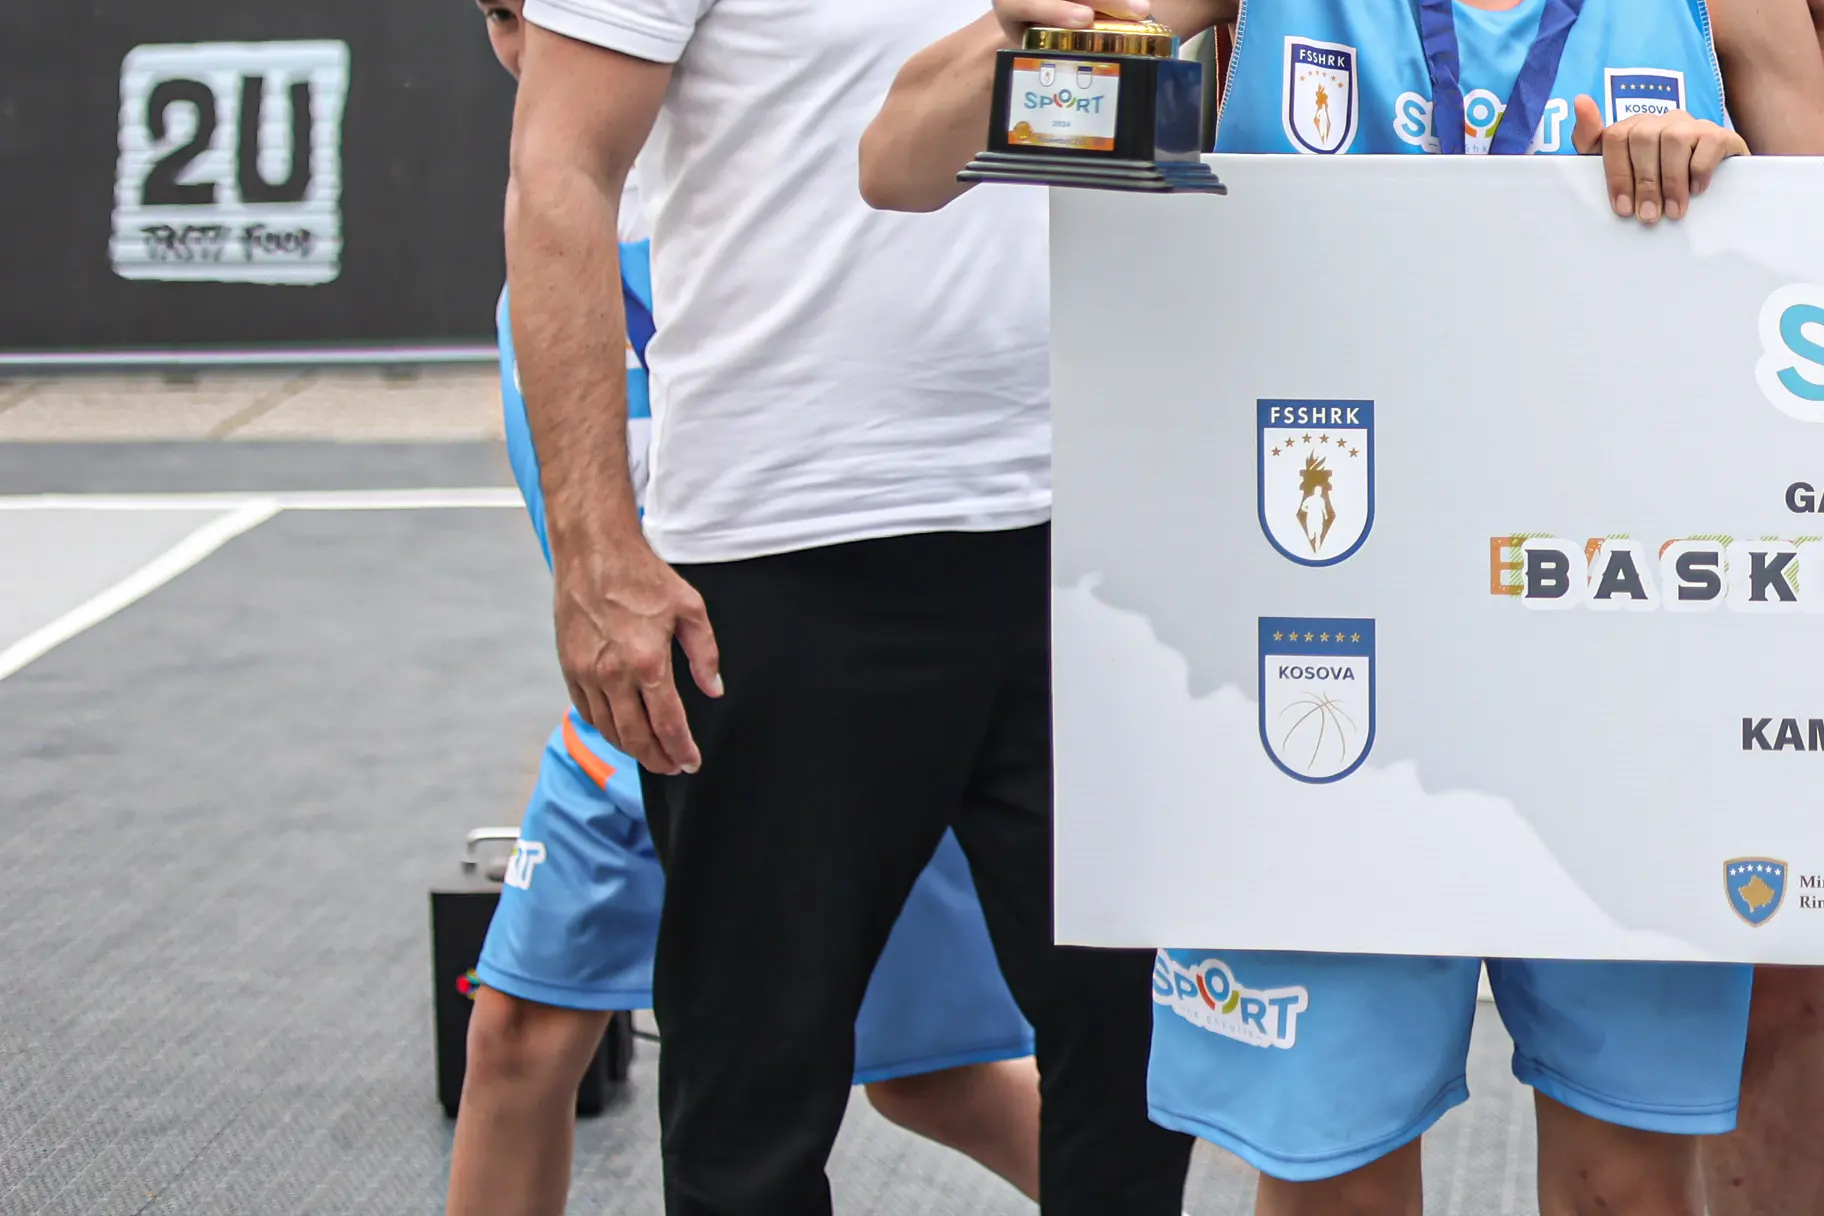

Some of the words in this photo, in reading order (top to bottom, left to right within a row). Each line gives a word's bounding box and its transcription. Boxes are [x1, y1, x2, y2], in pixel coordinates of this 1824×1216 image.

[1299, 48, 1346, 68] FSSHRK
[1024, 88, 1105, 114] SPORT
[1402, 96, 1561, 144] SOT
[141, 76, 313, 206] 2U
[1270, 406, 1361, 425] FSSHRK
[1278, 665, 1356, 681] KOSOVA
